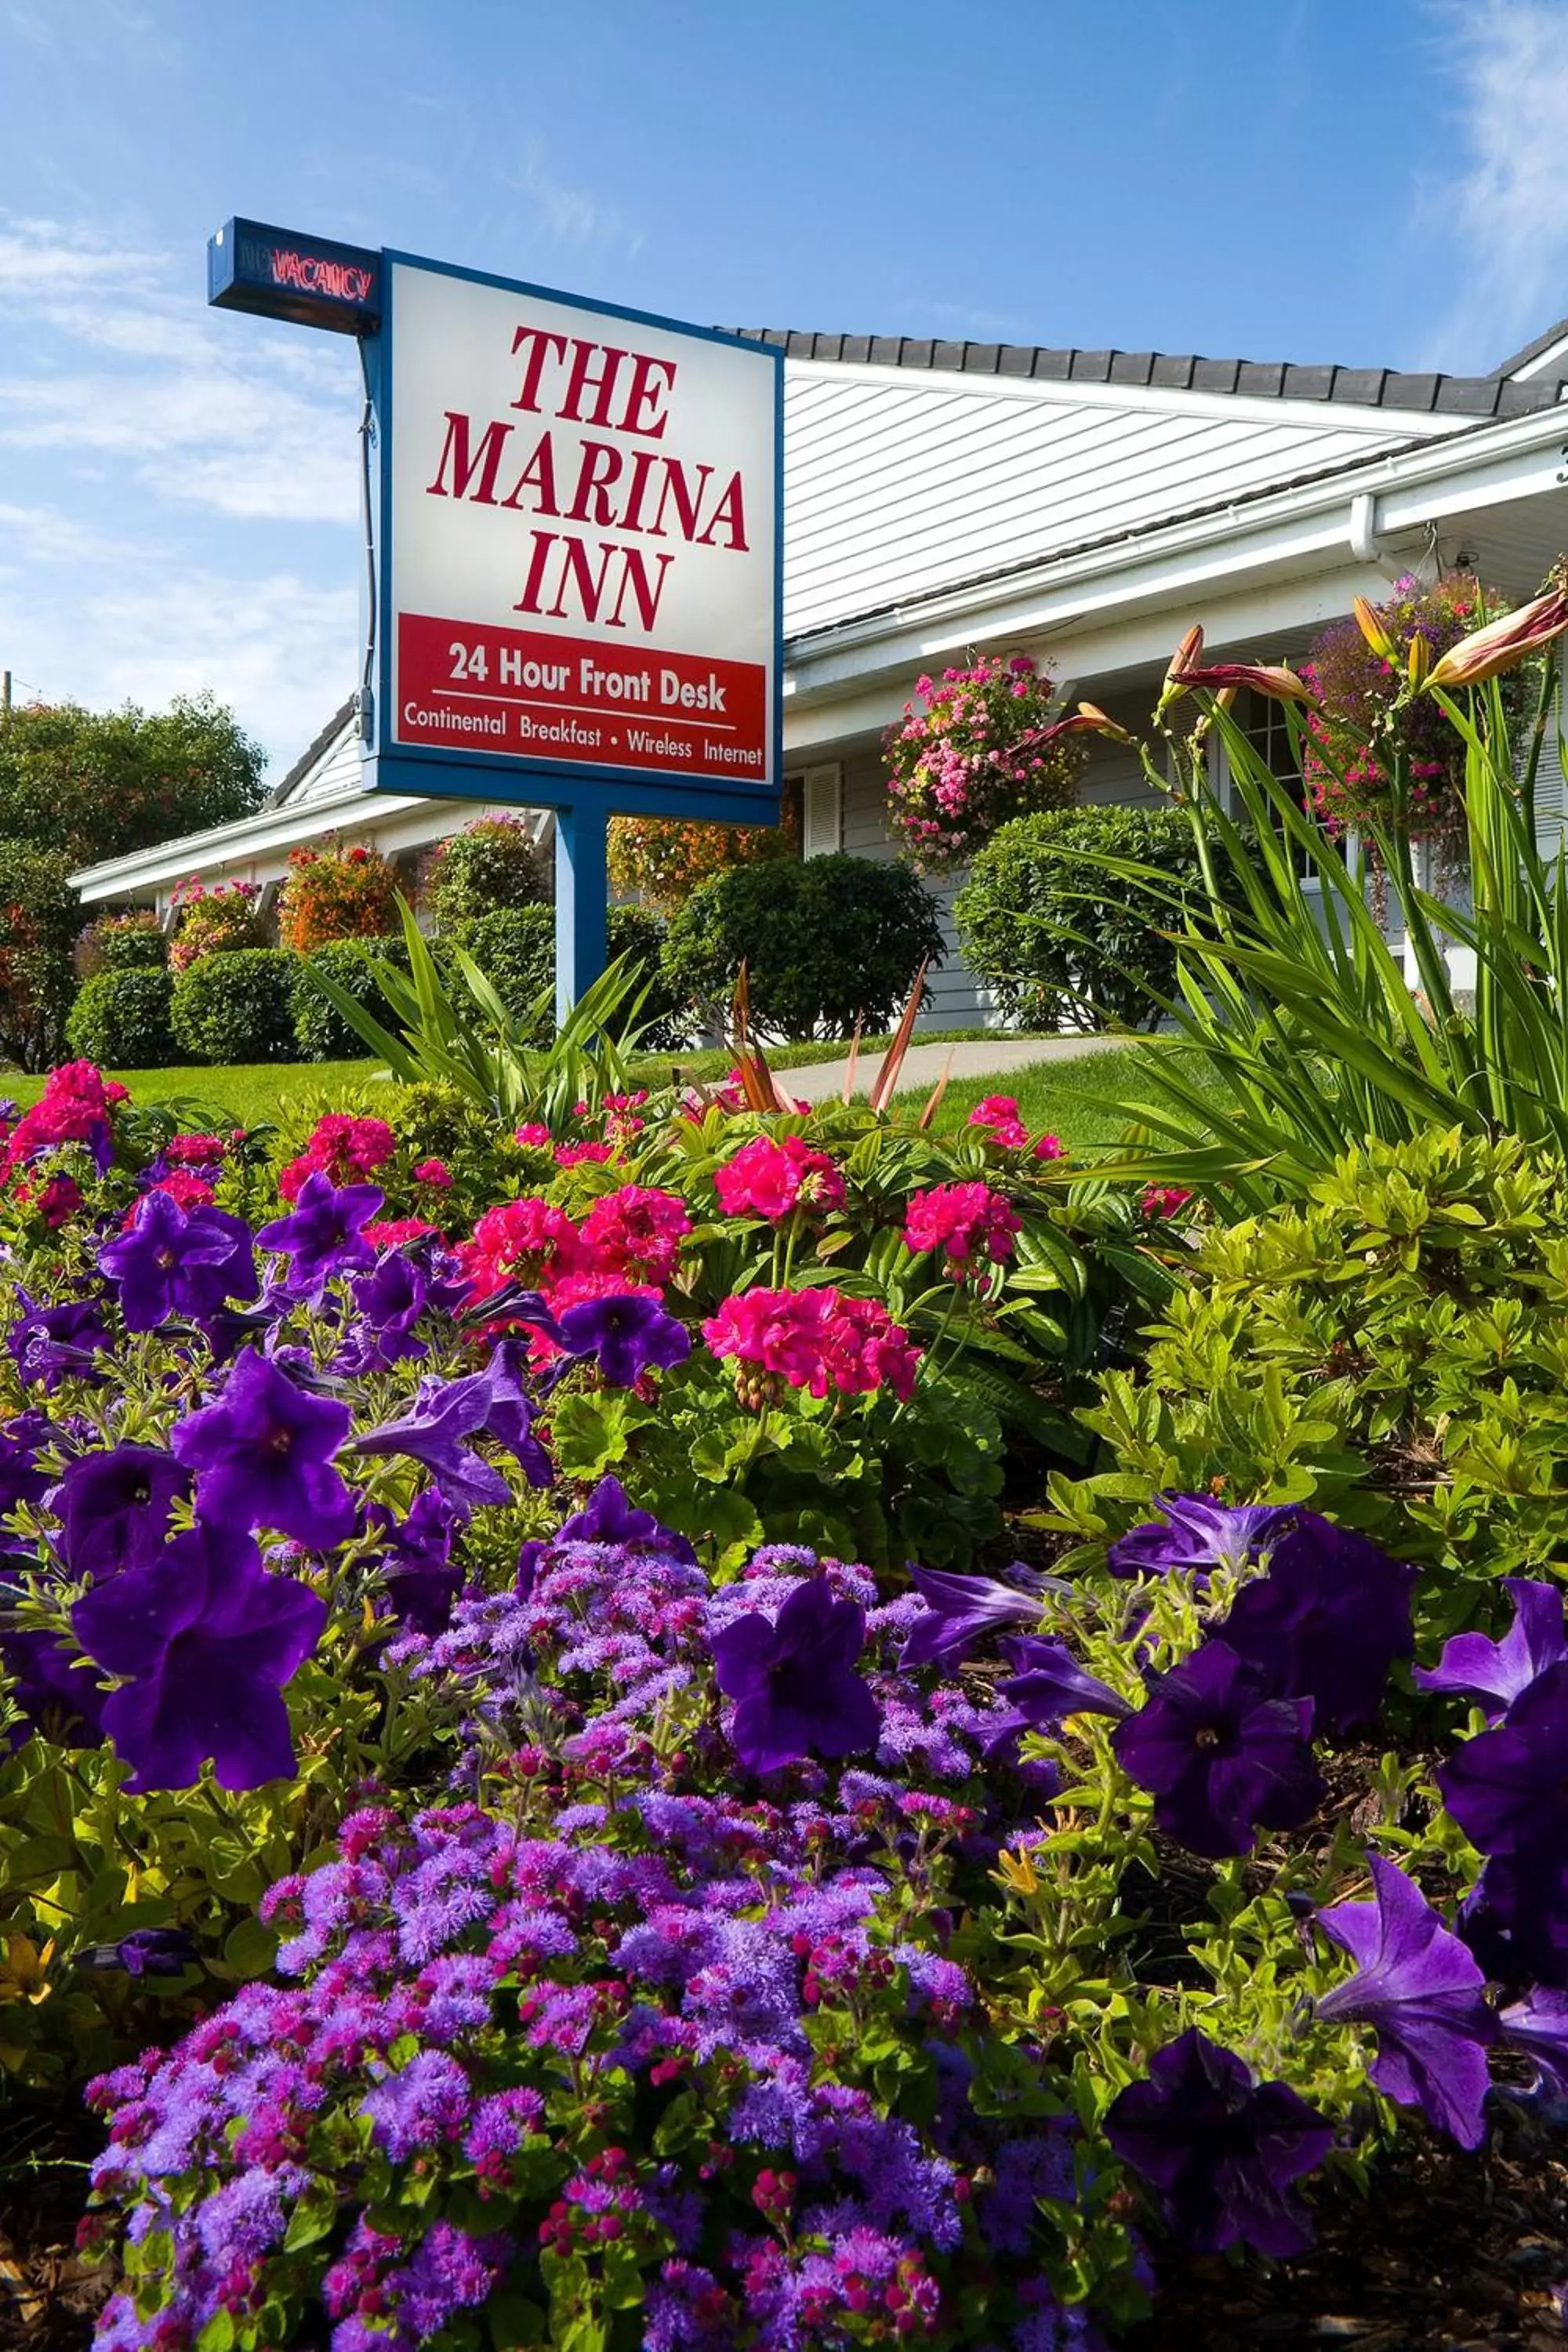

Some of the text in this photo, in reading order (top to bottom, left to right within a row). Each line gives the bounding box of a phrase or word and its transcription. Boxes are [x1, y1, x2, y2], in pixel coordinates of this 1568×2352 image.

[273, 249, 372, 301] VACANCY
[510, 325, 677, 439] THE
[426, 412, 750, 553] MARINA
[514, 530, 675, 632] INN
[448, 642, 727, 713] 24 Hour Front Desk
[404, 702, 763, 767] Continental Breakfast Wireless Internet
